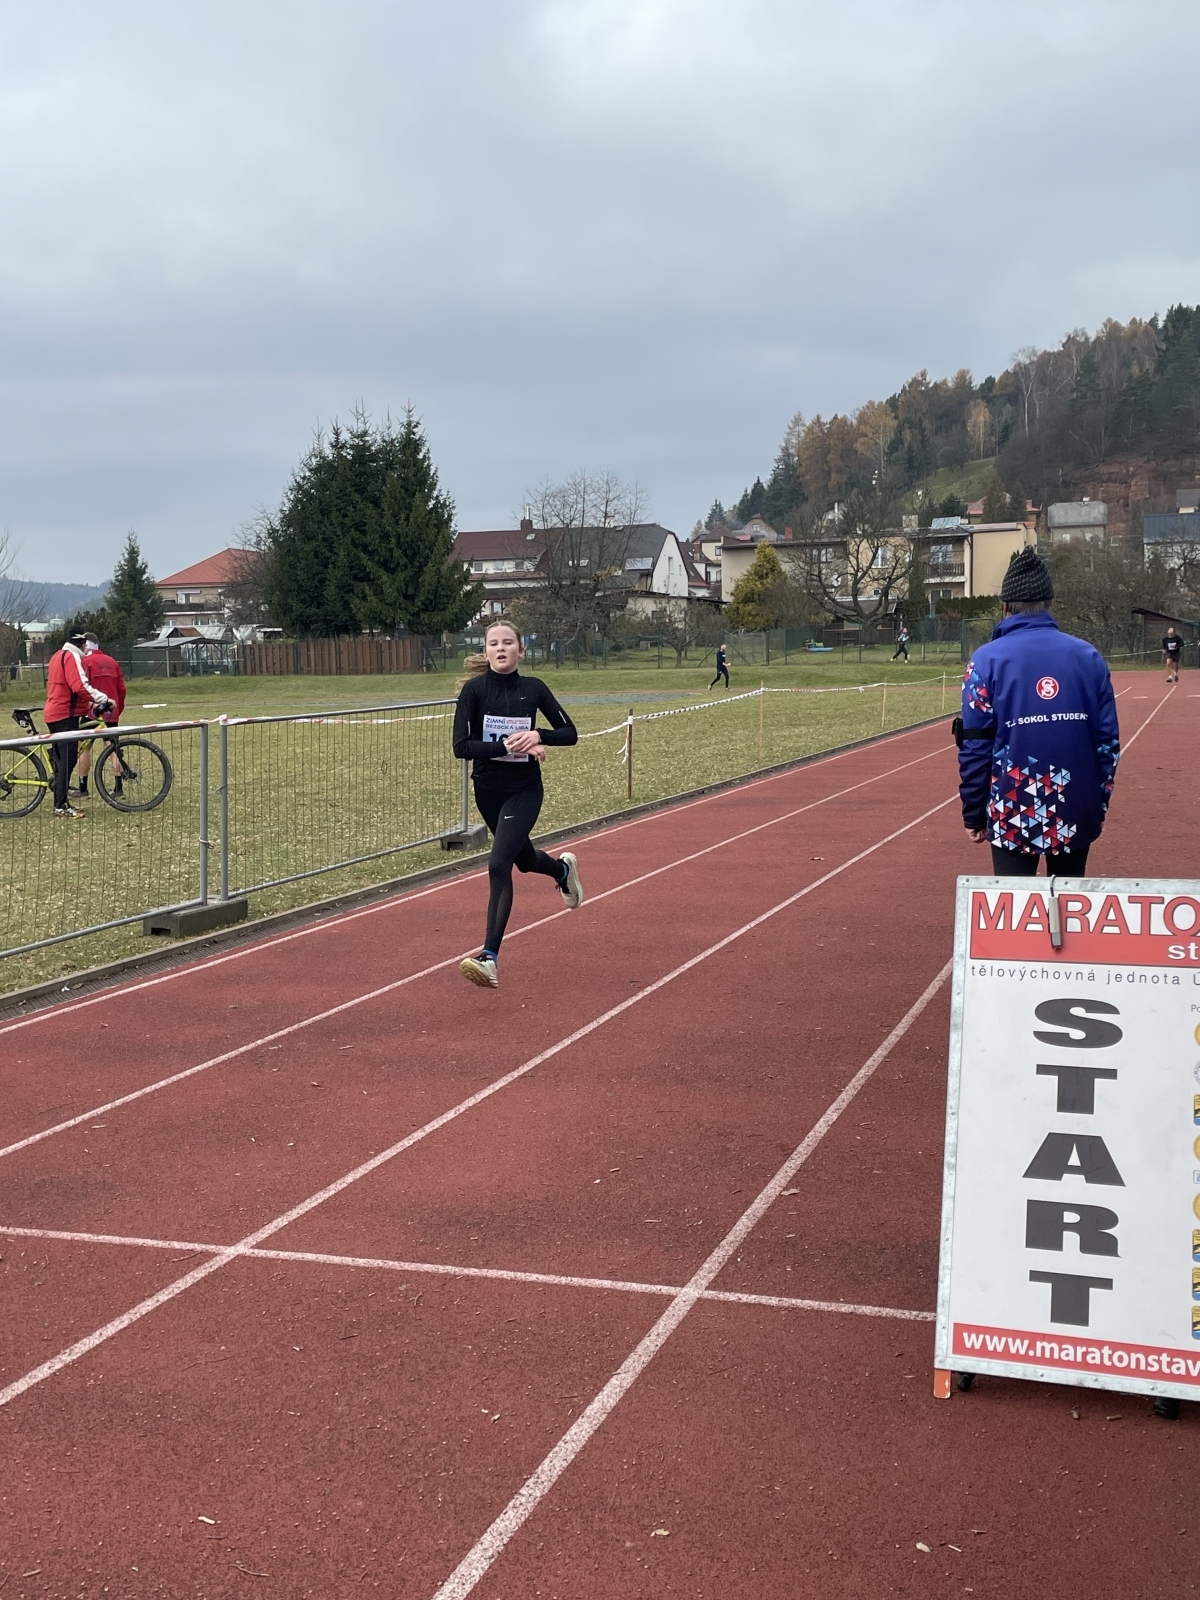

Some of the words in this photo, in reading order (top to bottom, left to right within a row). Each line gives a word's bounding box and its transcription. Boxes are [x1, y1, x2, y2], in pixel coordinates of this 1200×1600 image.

[1018, 715, 1049, 725] SOKOL
[972, 892, 1200, 937] MARATO
[1167, 942, 1199, 960] st
[971, 965, 1096, 982] tělovýchovná
[1106, 970, 1180, 985] jednota
[1022, 998, 1126, 1328] START
[962, 1332, 1200, 1377] www.maratonstav
